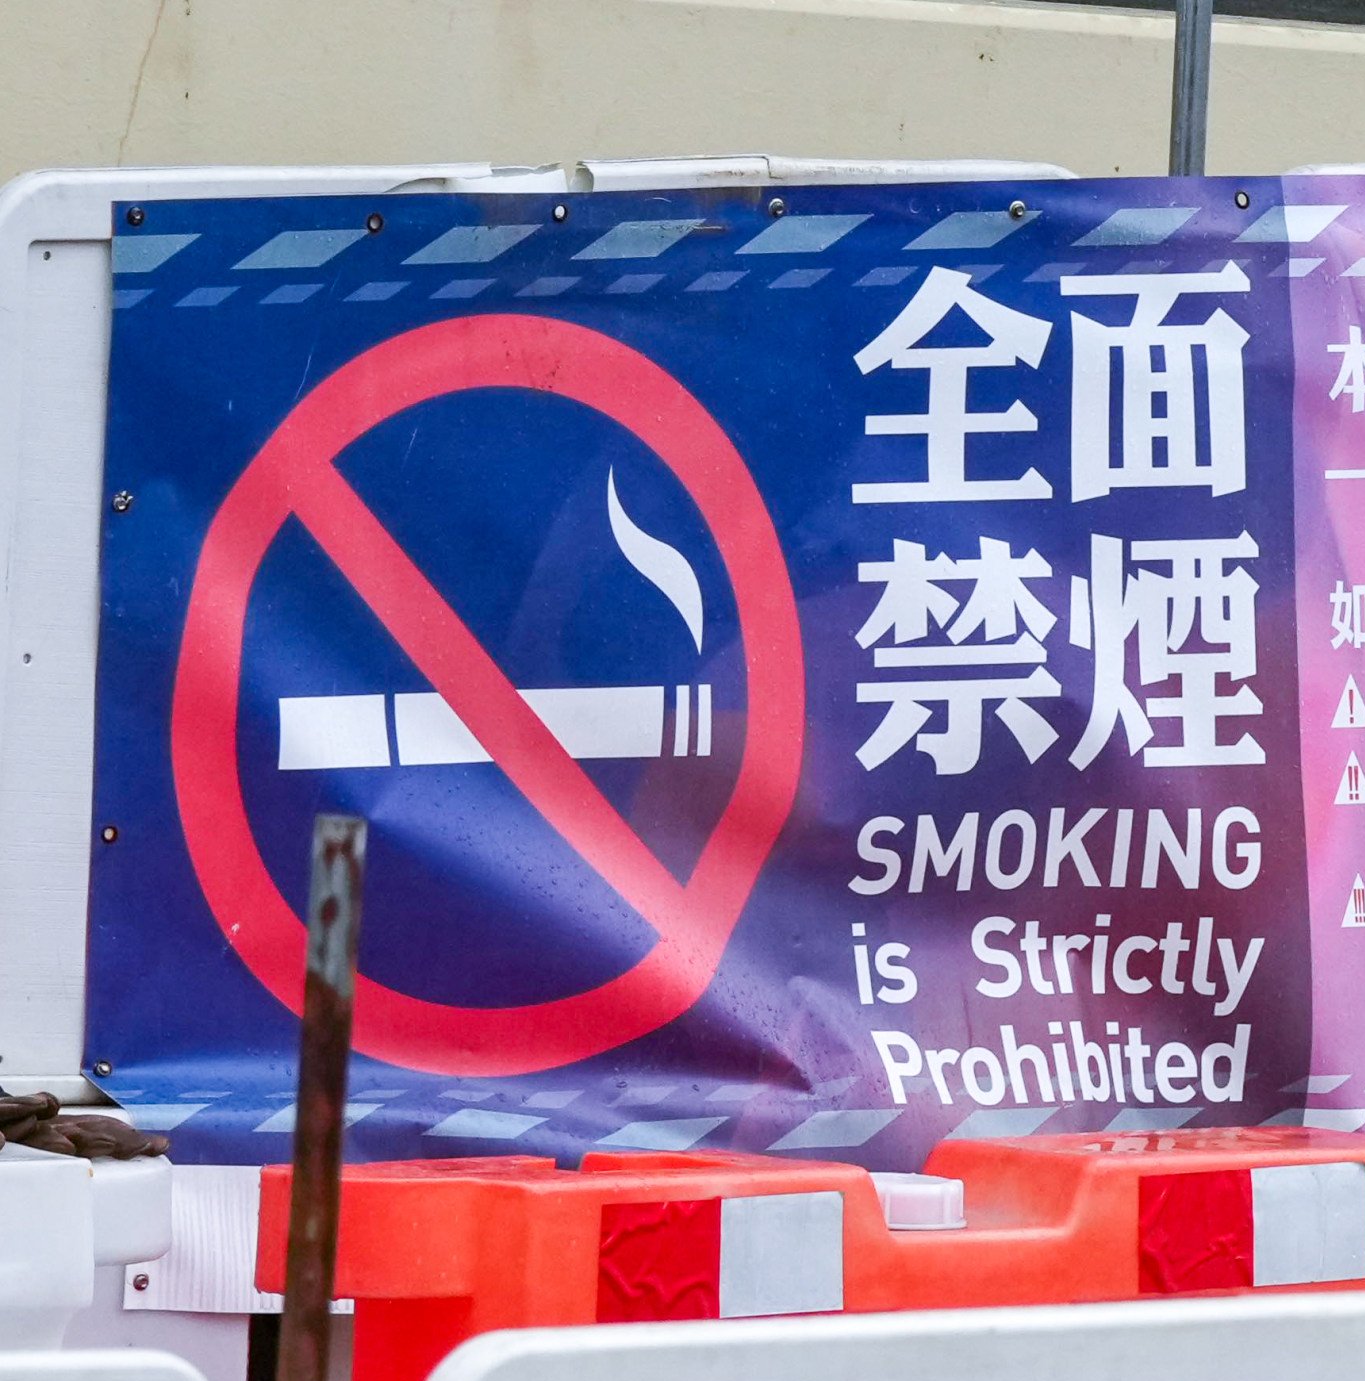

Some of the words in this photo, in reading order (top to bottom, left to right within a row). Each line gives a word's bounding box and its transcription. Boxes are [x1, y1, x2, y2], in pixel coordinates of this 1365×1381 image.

[852, 260, 1250, 503] 全面
[854, 529, 1266, 775] 禁煙
[848, 806, 1262, 895] SMOKING
[851, 922, 918, 1005] is
[971, 914, 1265, 1016] Strictly
[871, 1021, 1252, 1105] Prohibited
